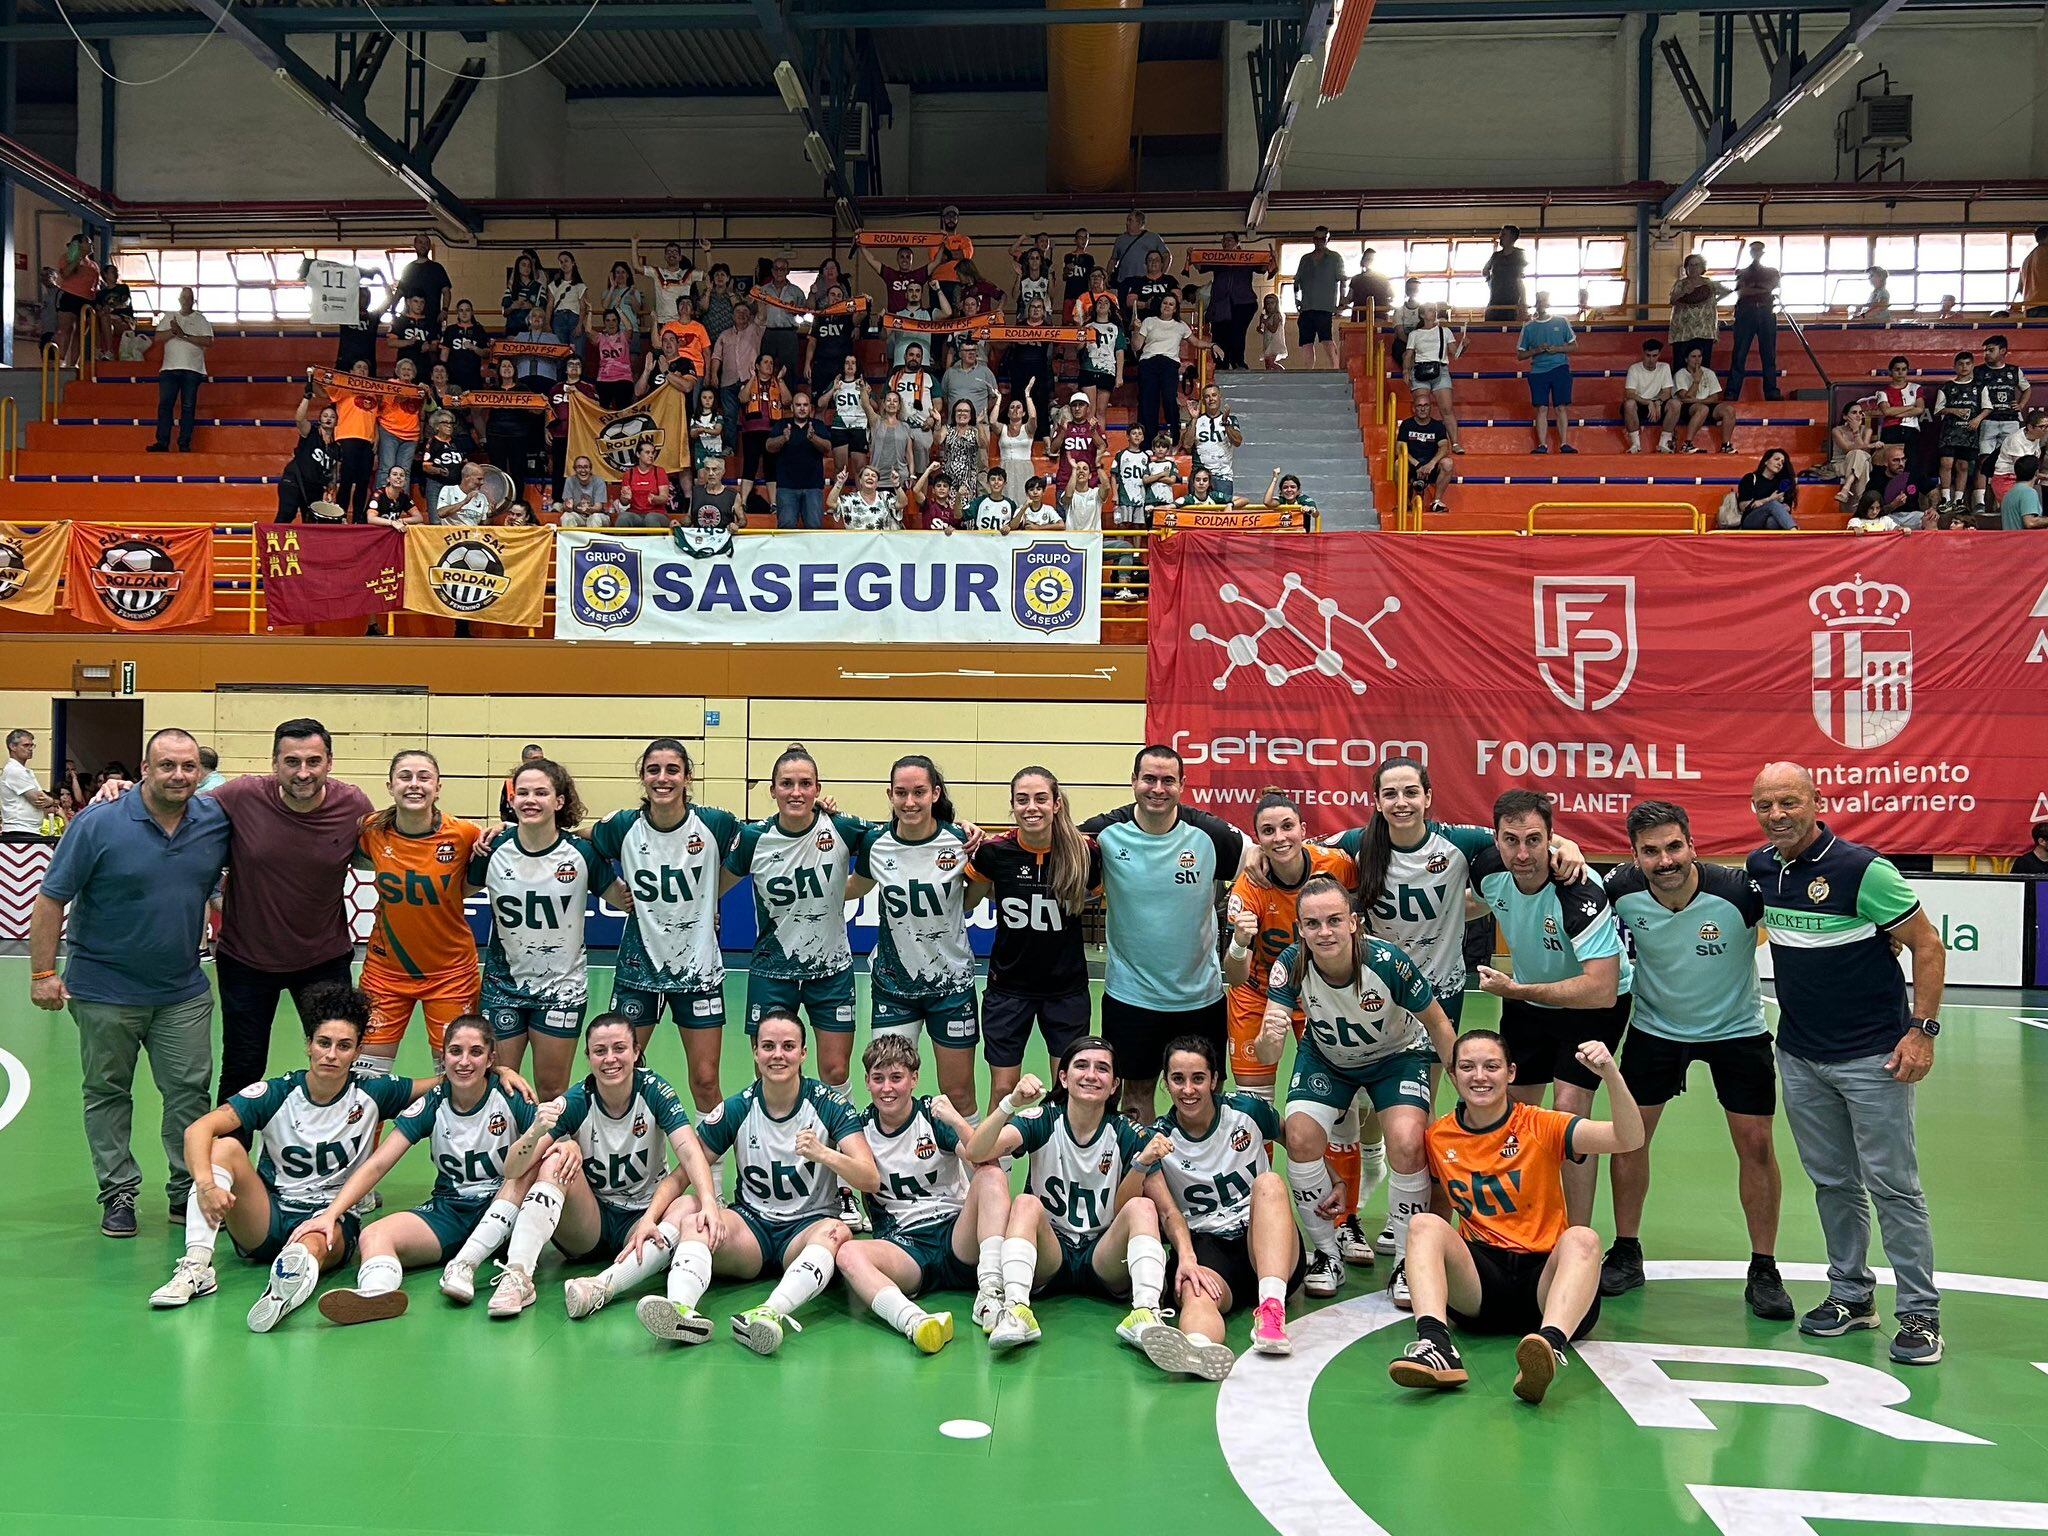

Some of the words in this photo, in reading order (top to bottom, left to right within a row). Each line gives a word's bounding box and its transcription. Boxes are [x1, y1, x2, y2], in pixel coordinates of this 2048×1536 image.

[873, 234, 910, 244] ROLDAN
[911, 234, 929, 244] FSF
[1202, 251, 1238, 262] ROLDAN
[1239, 252, 1255, 262] FSF
[321, 269, 347, 290] 11
[1004, 328, 1043, 339] ROLDAN
[1045, 329, 1061, 338] FSF
[474, 394, 515, 405] ROLDAN
[516, 395, 533, 404] FSF
[599, 411, 619, 424] FUT
[631, 404, 652, 415] SAL
[1064, 436, 1092, 450] stv
[1194, 515, 1238, 527] ROLDAN
[1241, 515, 1261, 527] FSF
[443, 529, 471, 546] FUT
[481, 533, 508, 555] SAL
[585, 551, 627, 563] GRUPO
[1026, 553, 1071, 564] GRUPO
[105, 574, 168, 588] ROLDÁN
[442, 571, 497, 589] ROLDÁN
[596, 576, 616, 598] S
[652, 562, 1002, 612] SASEGUR
[1039, 578, 1059, 602] S
[449, 601, 481, 611] FEMENINO
[582, 606, 631, 624] SASEGUR
[1024, 609, 1074, 626] SASEGUR
[1172, 730, 1429, 768] Getecom
[1475, 739, 1702, 780] FOOTBALL
[1807, 760, 1970, 786] ntamiento
[1547, 792, 1632, 814] PLANET
[1818, 790, 1976, 814] avalcarnero
[633, 864, 703, 903] stv
[765, 863, 834, 906] stv
[883, 878, 951, 918] stv
[495, 890, 573, 930] stv
[1695, 942, 1728, 957] stv
[744, 1160, 816, 1202] stv
